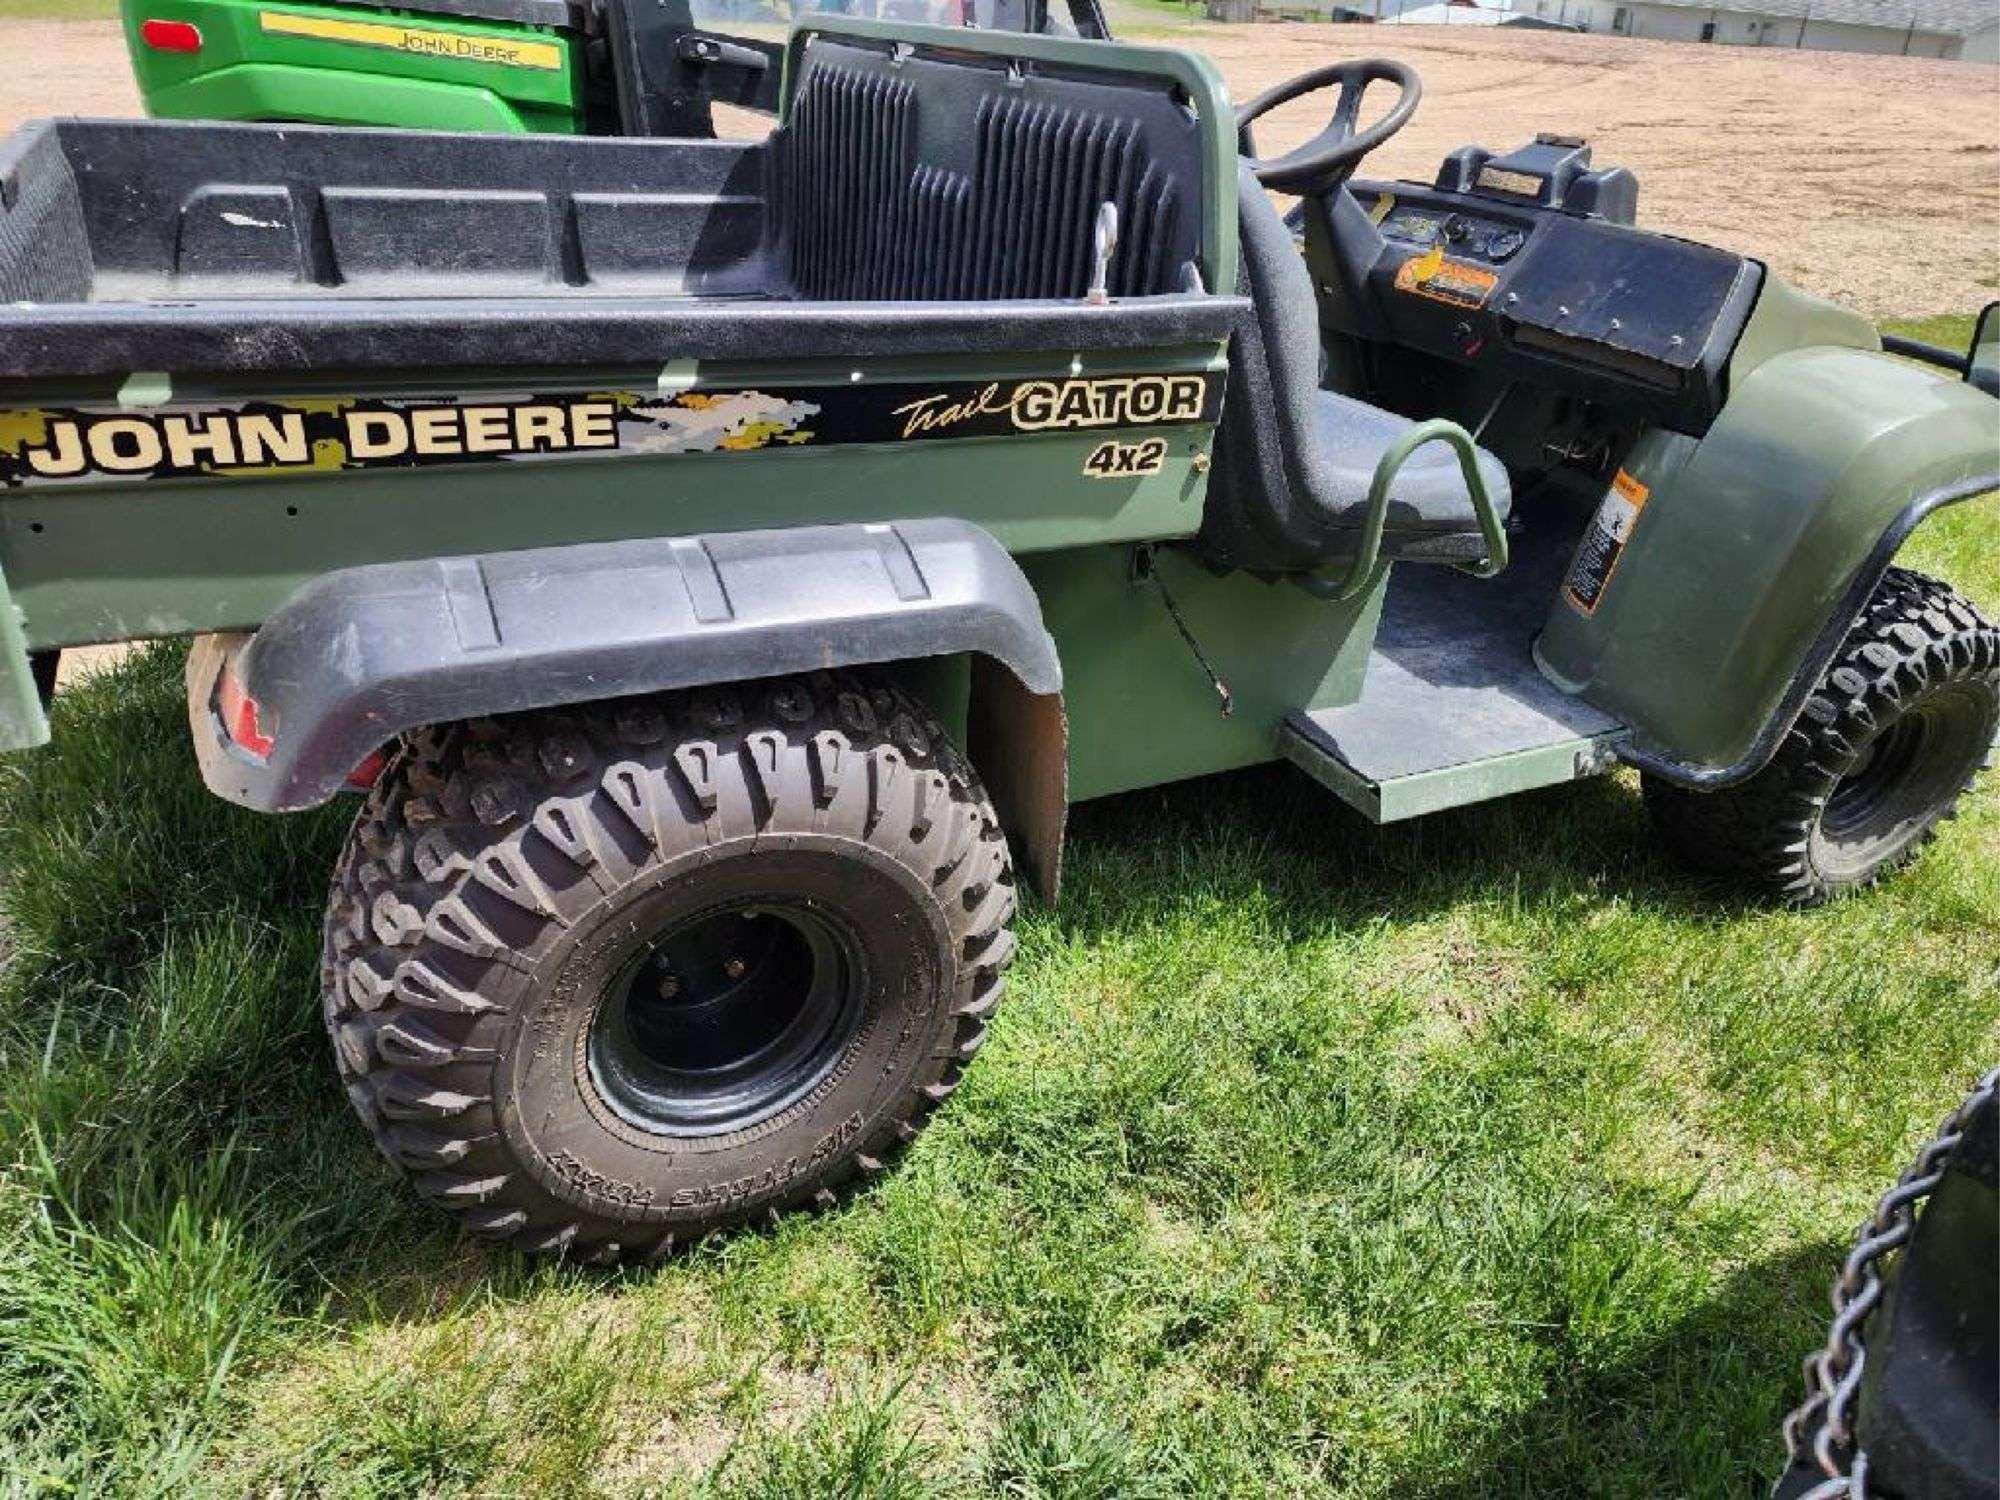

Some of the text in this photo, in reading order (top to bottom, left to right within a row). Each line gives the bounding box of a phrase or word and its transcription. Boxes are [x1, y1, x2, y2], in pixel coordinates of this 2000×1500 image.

[398, 32, 521, 62] JOHN DEERE
[891, 376, 1206, 439] Trail GATOR
[27, 402, 619, 476] JOHN DEERE
[1083, 437, 1168, 479] 4x2
